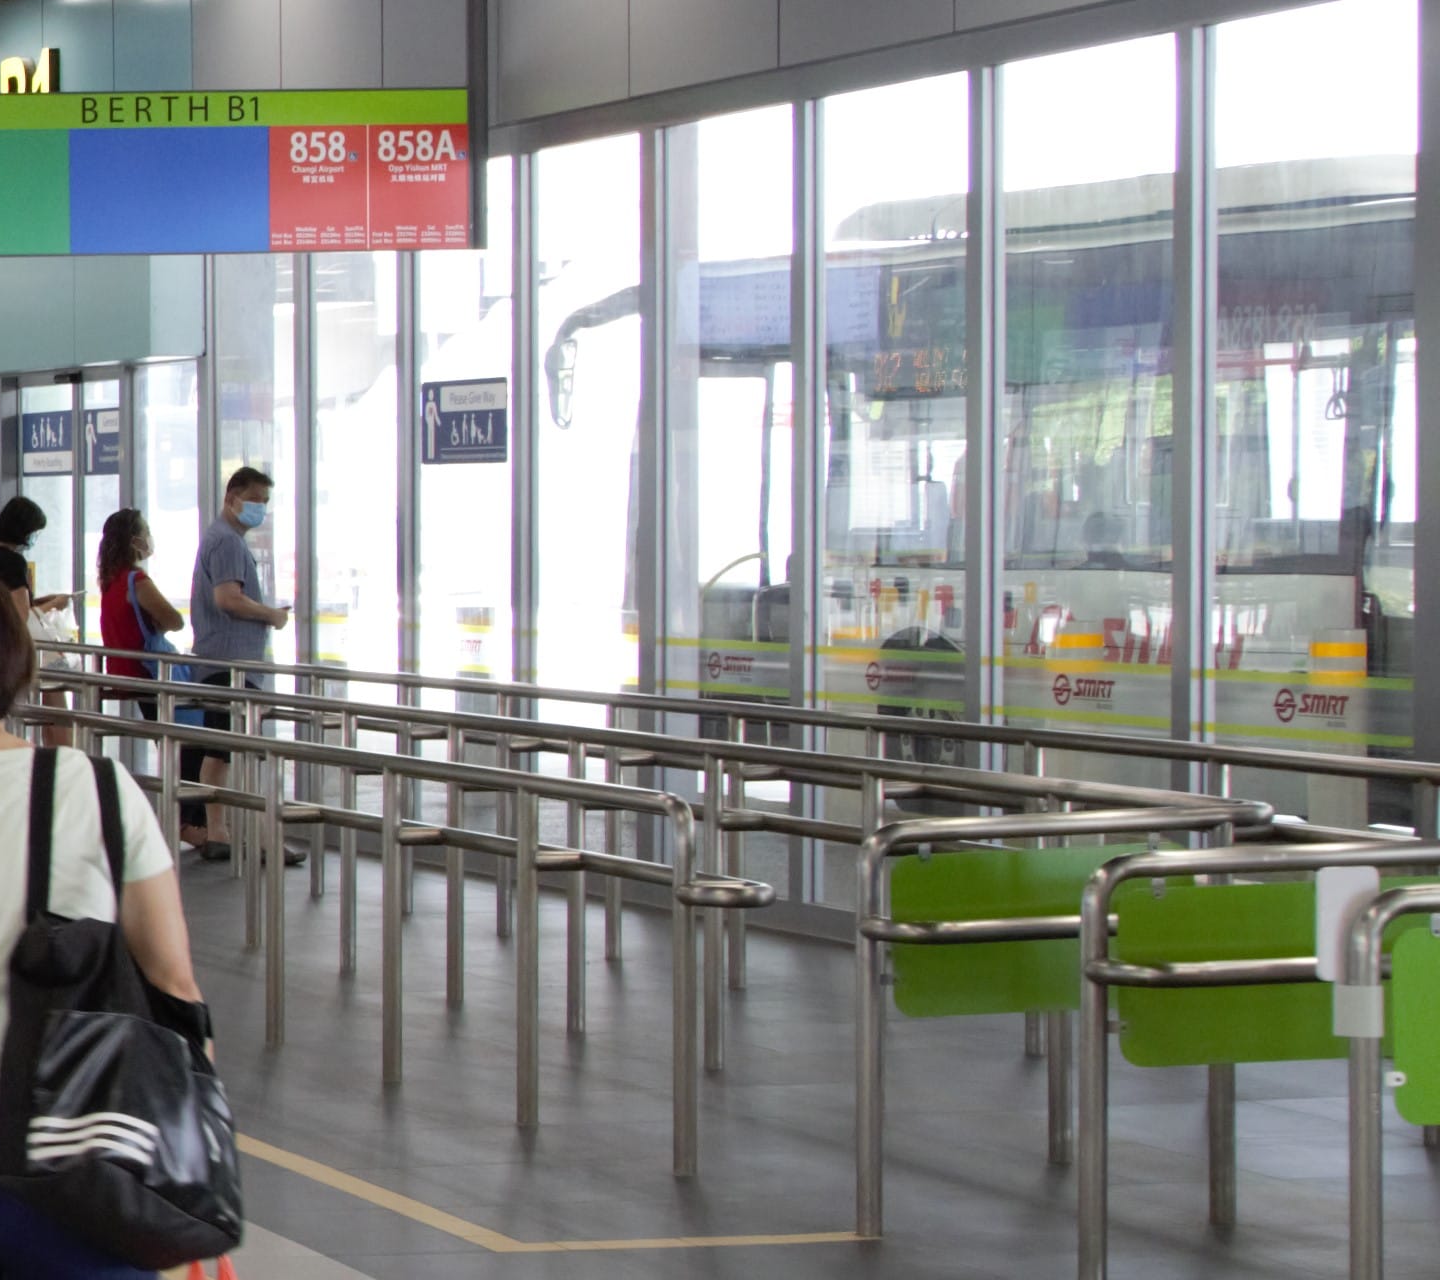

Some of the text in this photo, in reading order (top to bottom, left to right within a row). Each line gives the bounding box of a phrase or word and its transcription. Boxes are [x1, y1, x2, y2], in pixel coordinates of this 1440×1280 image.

[82, 96, 260, 123] BERTH B1
[290, 131, 346, 163] 858
[378, 130, 456, 162] 858A
[1073, 678, 1114, 699] SMRT
[1298, 693, 1349, 716] SMRT
